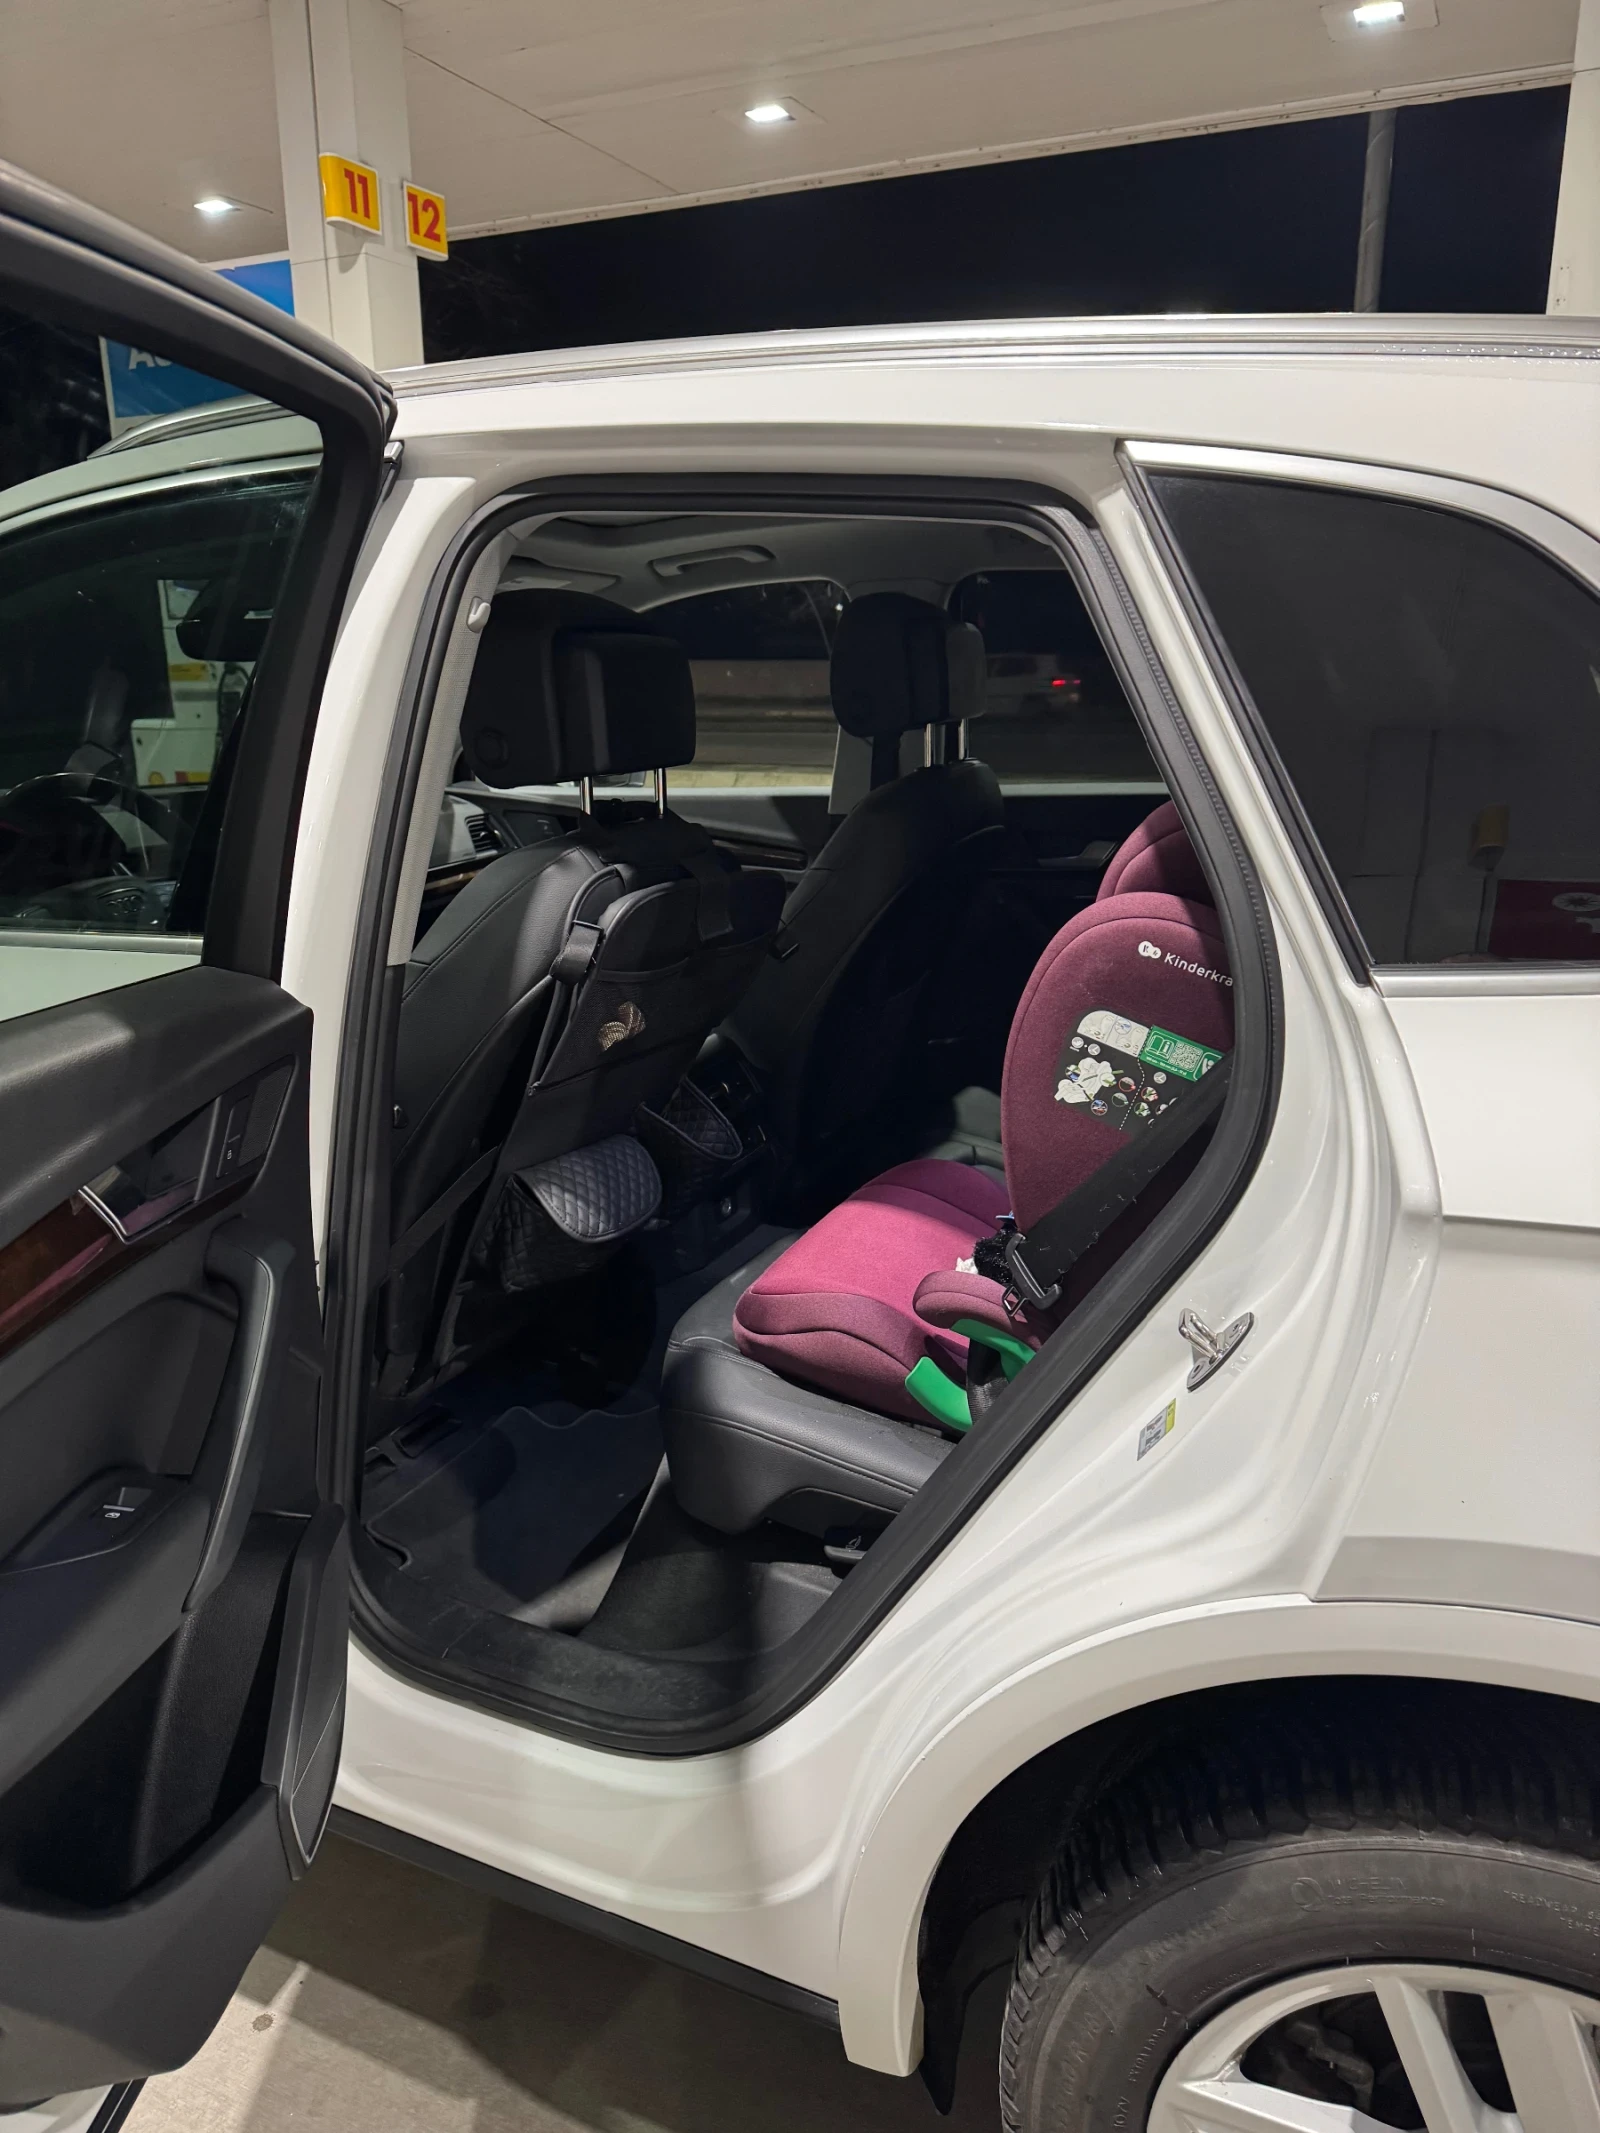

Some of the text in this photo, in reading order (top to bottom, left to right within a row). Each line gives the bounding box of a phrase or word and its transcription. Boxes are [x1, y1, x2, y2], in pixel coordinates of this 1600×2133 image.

[343, 167, 371, 220] 11
[407, 191, 441, 243] 12
[1164, 952, 1233, 987] Kinderkra
